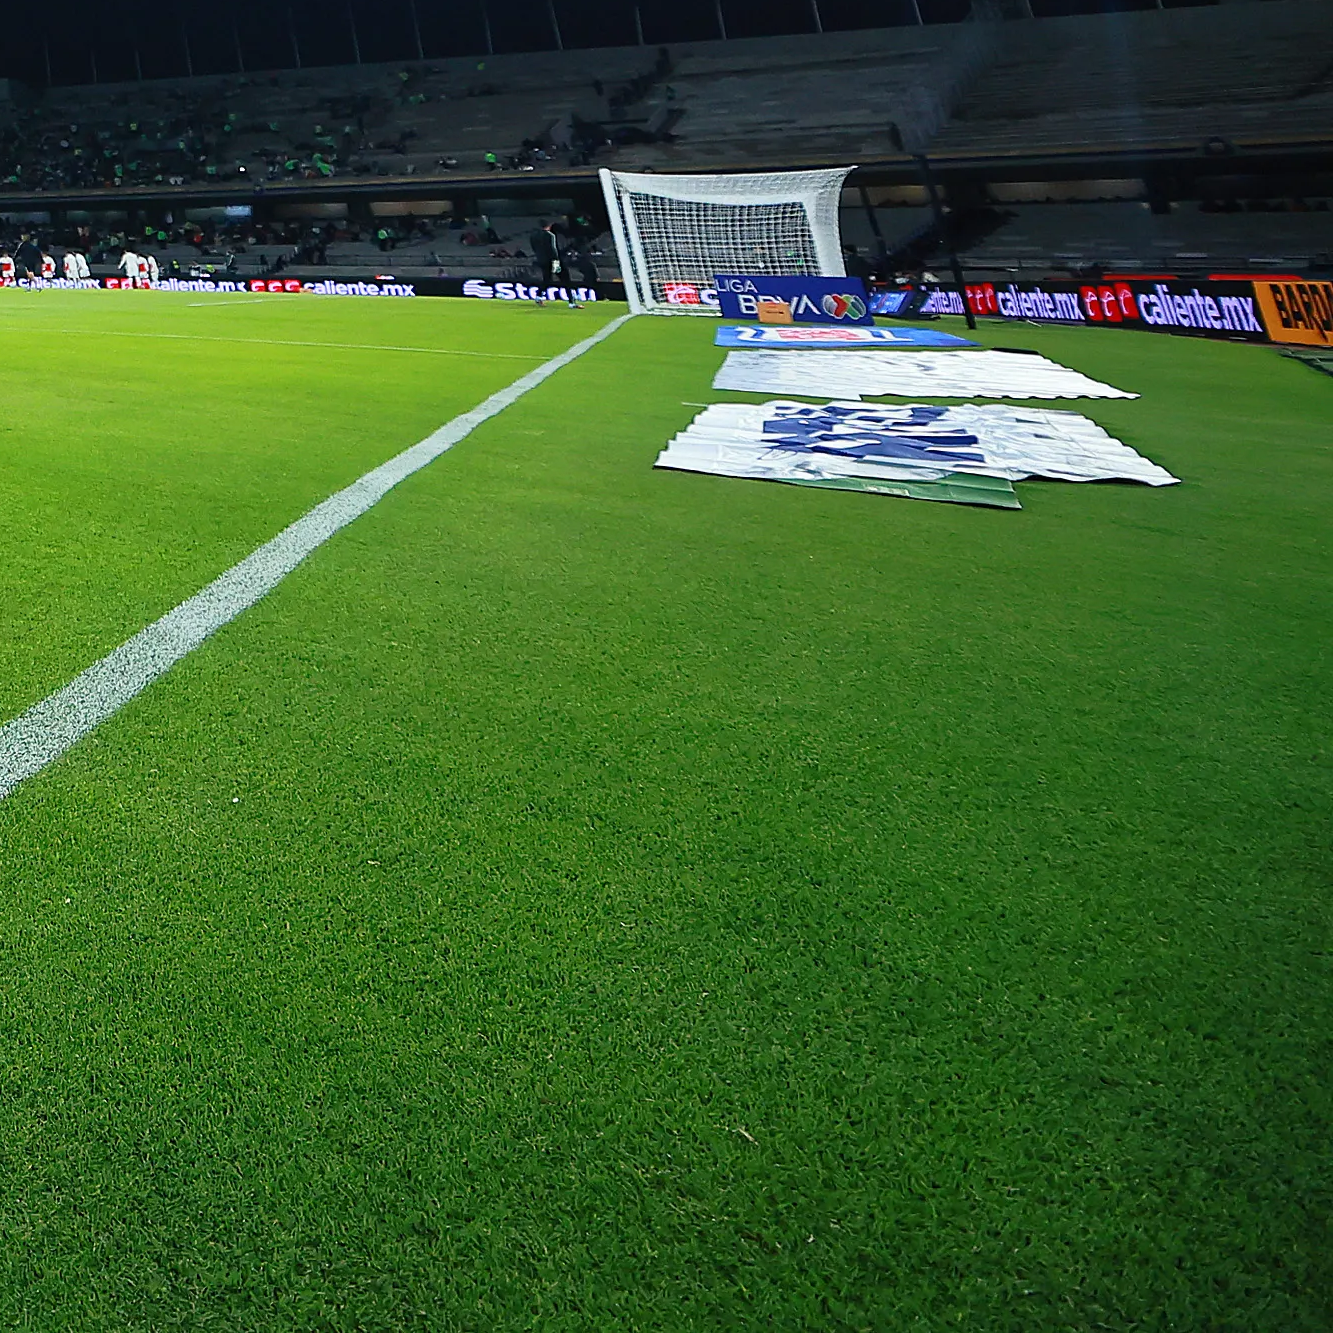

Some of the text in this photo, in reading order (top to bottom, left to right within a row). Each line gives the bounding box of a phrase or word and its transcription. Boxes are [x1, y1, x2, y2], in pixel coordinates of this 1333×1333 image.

[303, 280, 415, 296] caliente.mx
[715, 279, 758, 294] LIGA
[996, 283, 1085, 320] caliente.mx
[1138, 284, 1263, 333] caliente.mx
